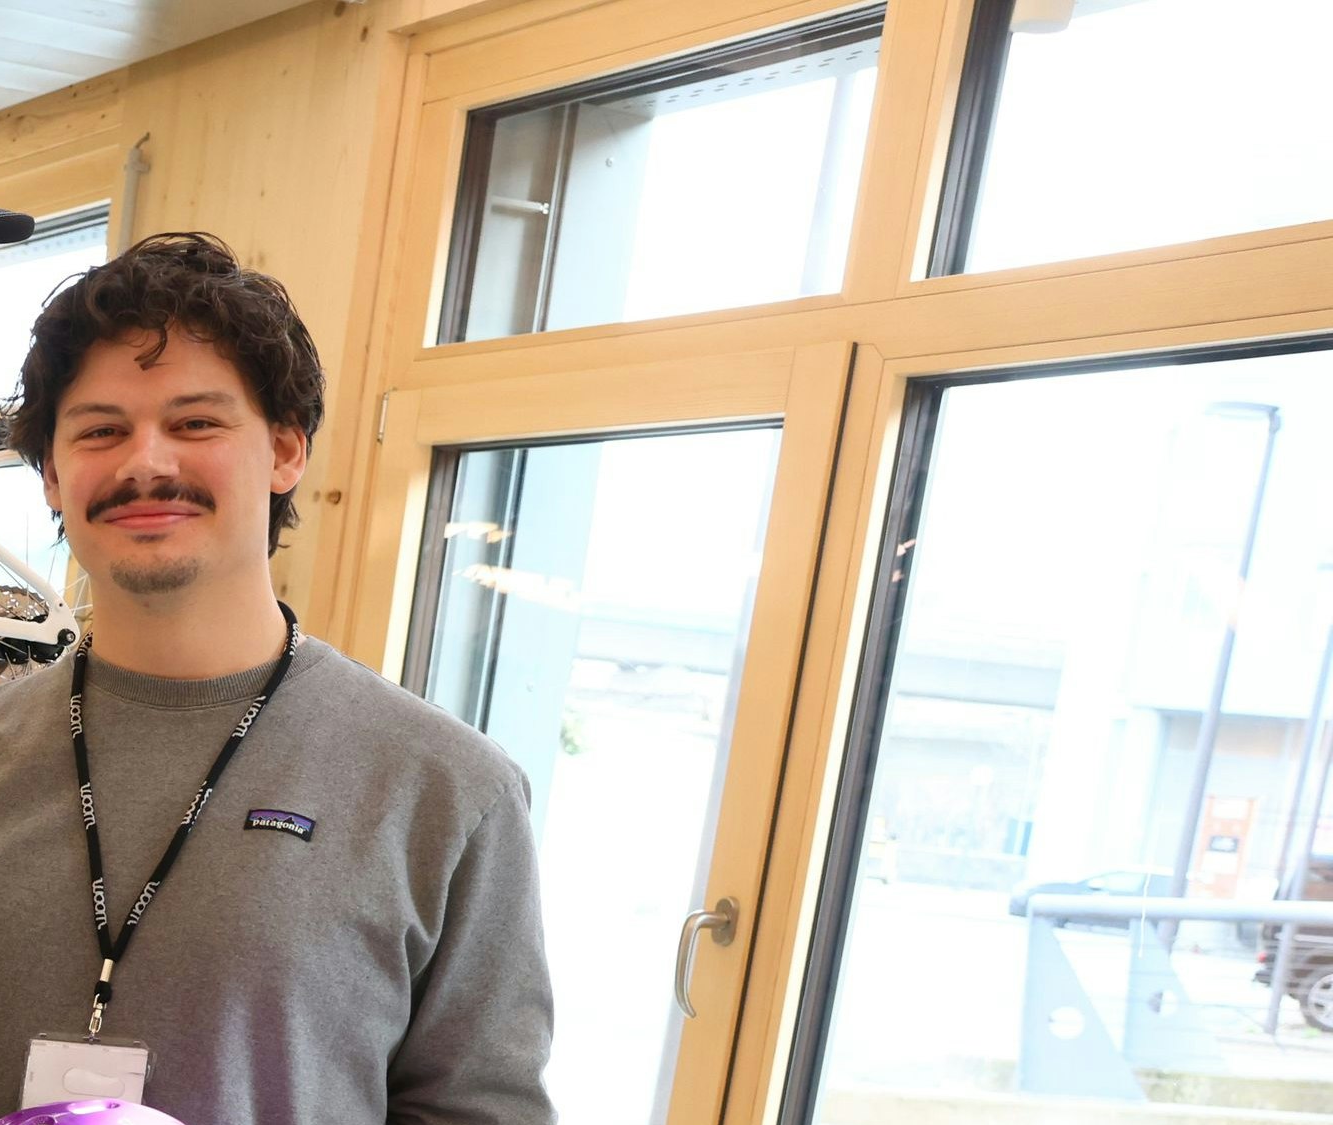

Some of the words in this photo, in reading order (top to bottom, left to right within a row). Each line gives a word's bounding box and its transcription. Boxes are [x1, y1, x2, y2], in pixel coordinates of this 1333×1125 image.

[70, 693, 83, 739] woom
[232, 695, 267, 738] woom
[80, 782, 96, 830] woom
[252, 818, 306, 835] patagonia
[92, 877, 108, 930] woom
[127, 880, 161, 926] woom
